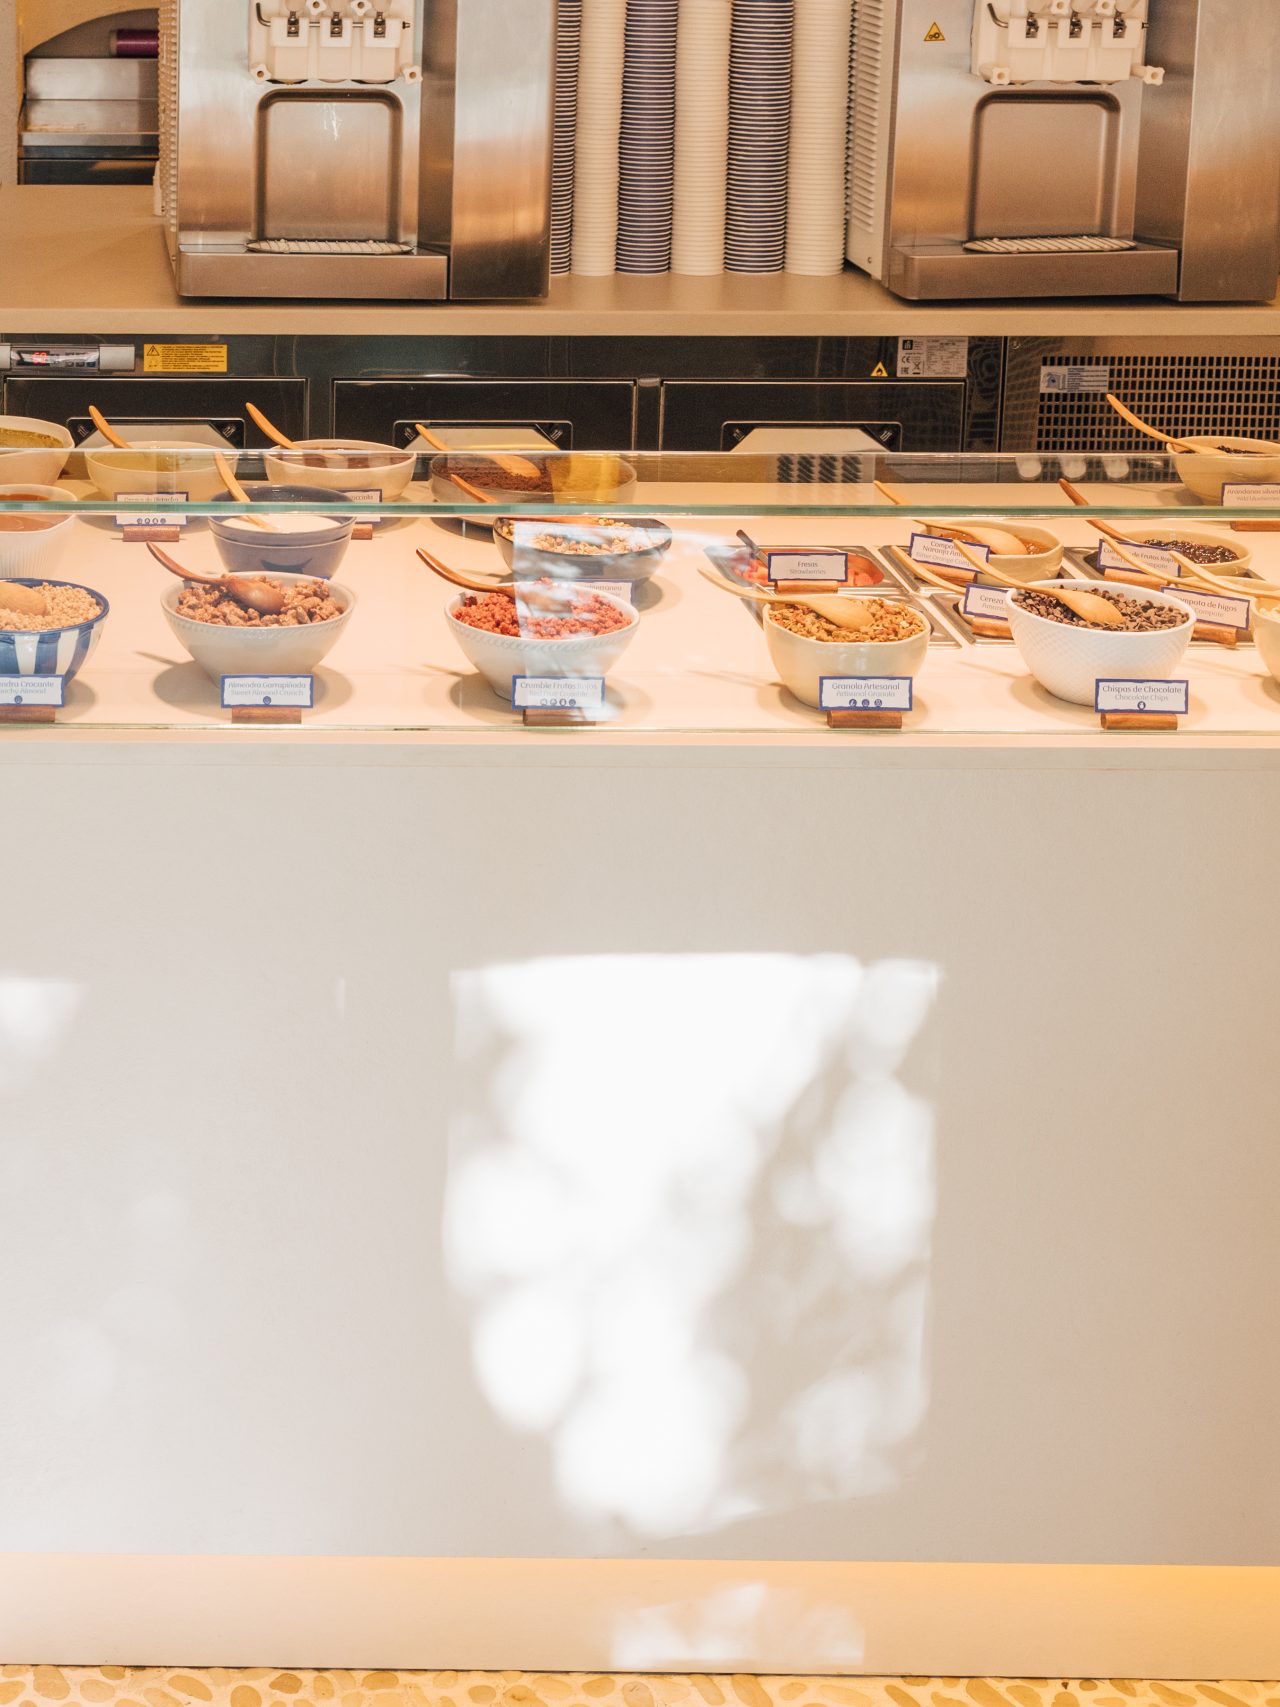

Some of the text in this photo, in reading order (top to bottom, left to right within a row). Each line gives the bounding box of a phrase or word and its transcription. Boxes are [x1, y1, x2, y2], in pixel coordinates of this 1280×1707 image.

[831, 682, 900, 690] Granola Artesanal
[1102, 685, 1132, 694] Chispas
[1143, 686, 1182, 694] Chocolate
